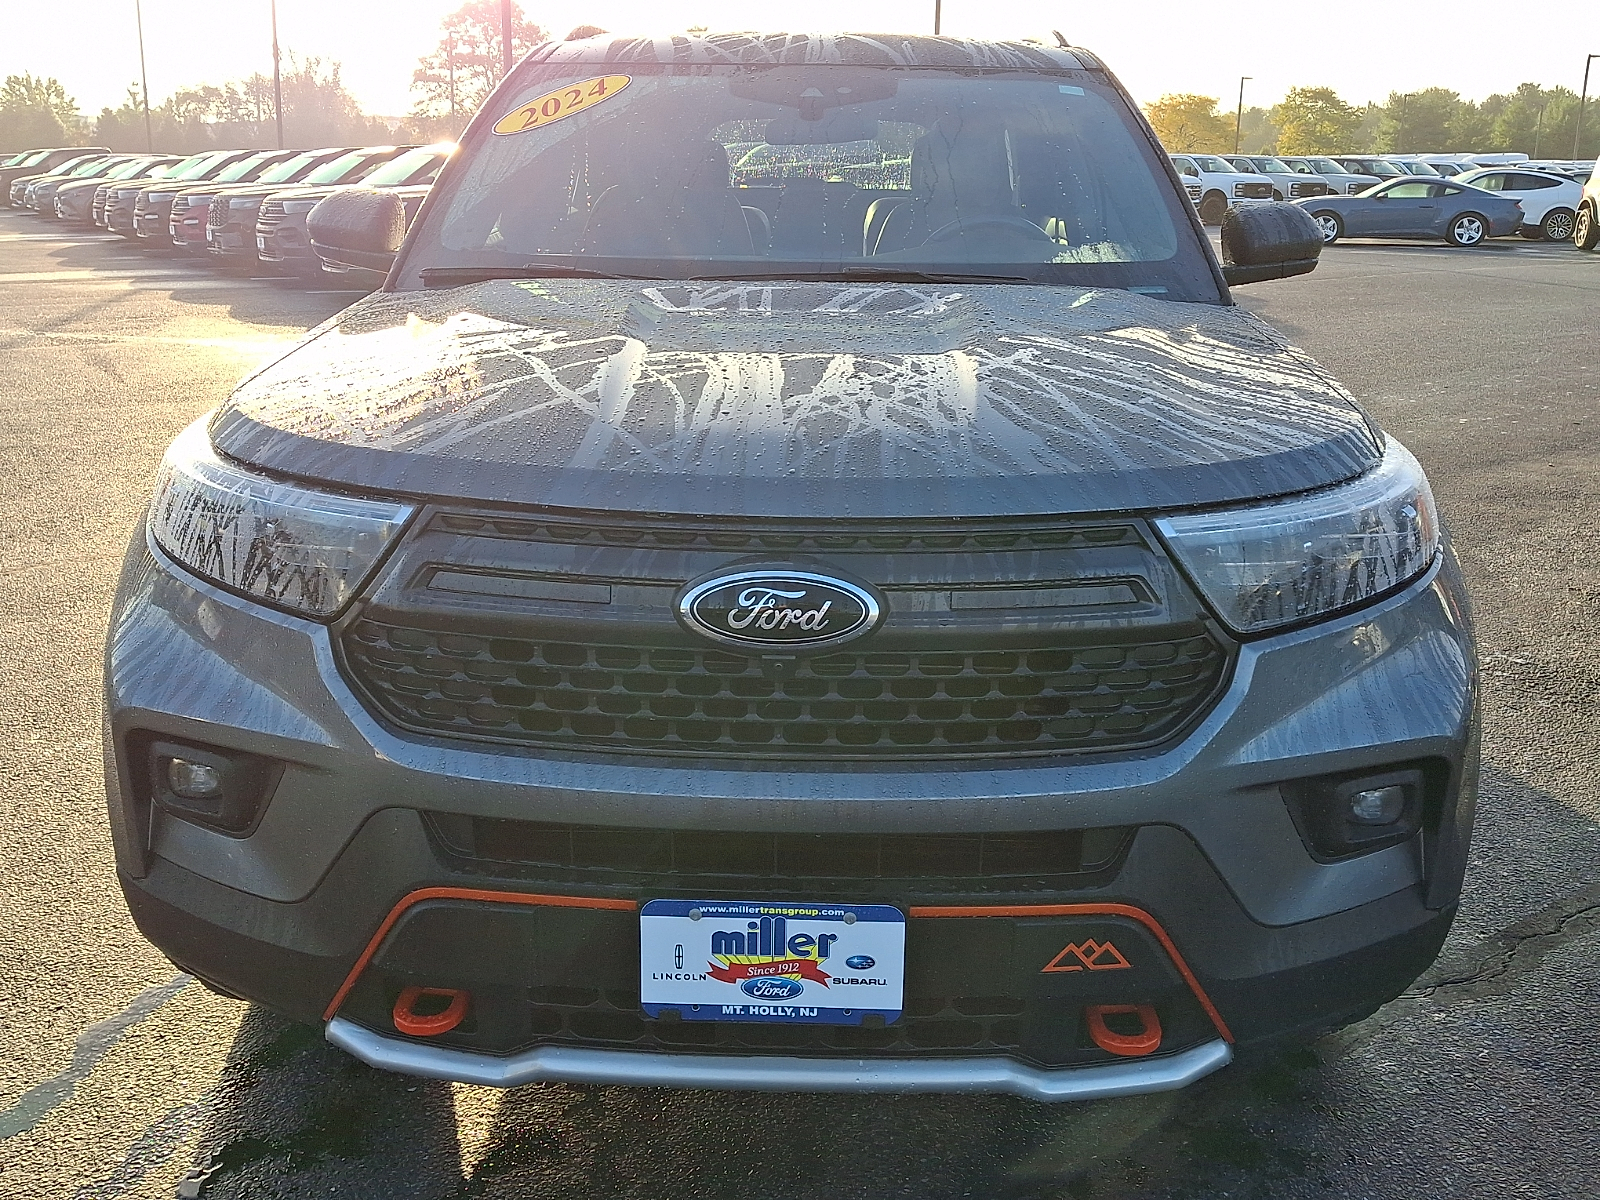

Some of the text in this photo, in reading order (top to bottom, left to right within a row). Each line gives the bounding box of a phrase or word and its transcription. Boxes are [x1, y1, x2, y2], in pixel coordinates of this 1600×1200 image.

[519, 78, 608, 129] 2024
[728, 587, 832, 631] Ford
[699, 905, 845, 917] www.millertransgroup.com
[711, 916, 838, 957] miller
[652, 972, 707, 981] LINCOLN
[747, 961, 800, 977] Since 1912
[753, 979, 791, 998] Ford
[832, 977, 887, 986] SUBARU
[722, 1005, 818, 1017] MT. HOLLY, NJ
